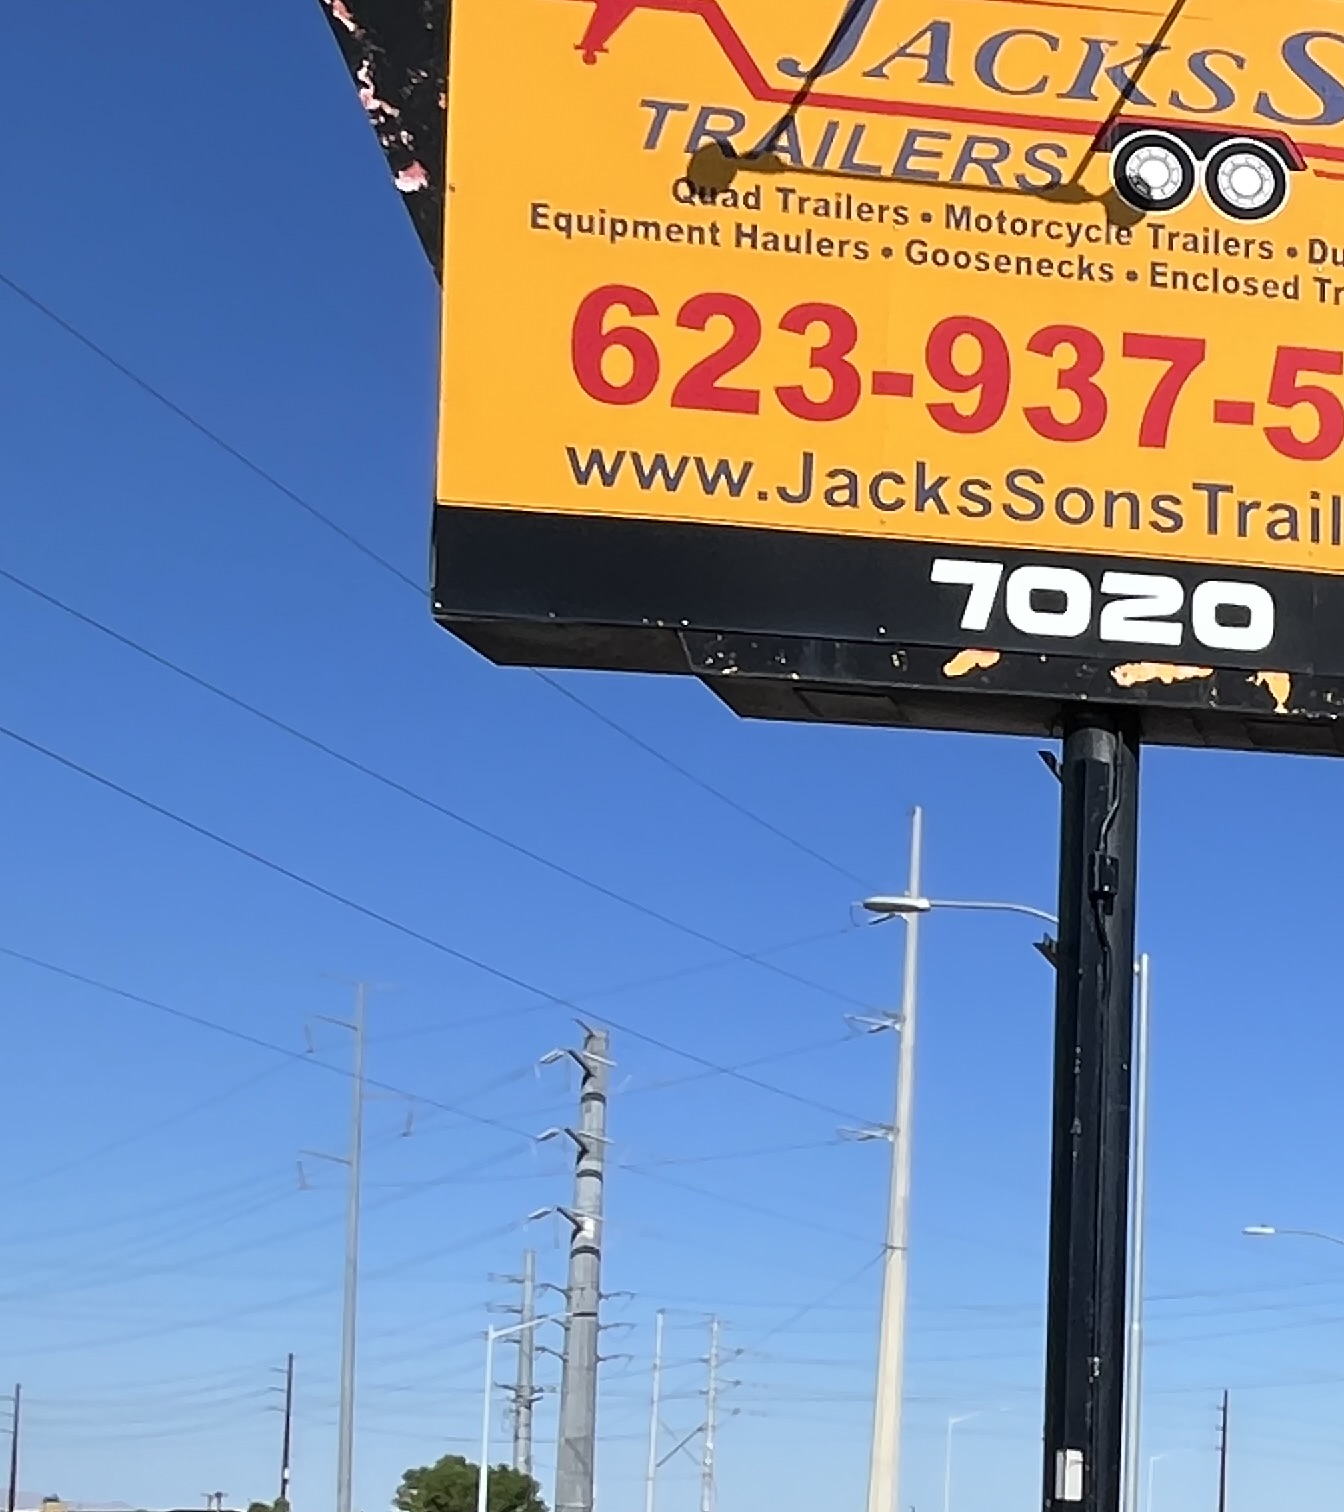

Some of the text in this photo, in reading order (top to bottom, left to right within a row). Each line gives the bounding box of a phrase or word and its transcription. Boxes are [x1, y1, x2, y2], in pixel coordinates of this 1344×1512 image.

[640, 98, 1068, 193] TRAILERS
[530, 202, 720, 248] Equipment
[734, 223, 870, 261] Haulers
[905, 239, 1114, 283] Goosenecks
[1148, 261, 1300, 303] Enclosed
[671, 176, 762, 212] Quad
[775, 186, 910, 227] Trailers
[944, 203, 1133, 248] Motorcycle
[1147, 222, 1274, 261] Trailers
[930, 557, 1276, 652] 7020
